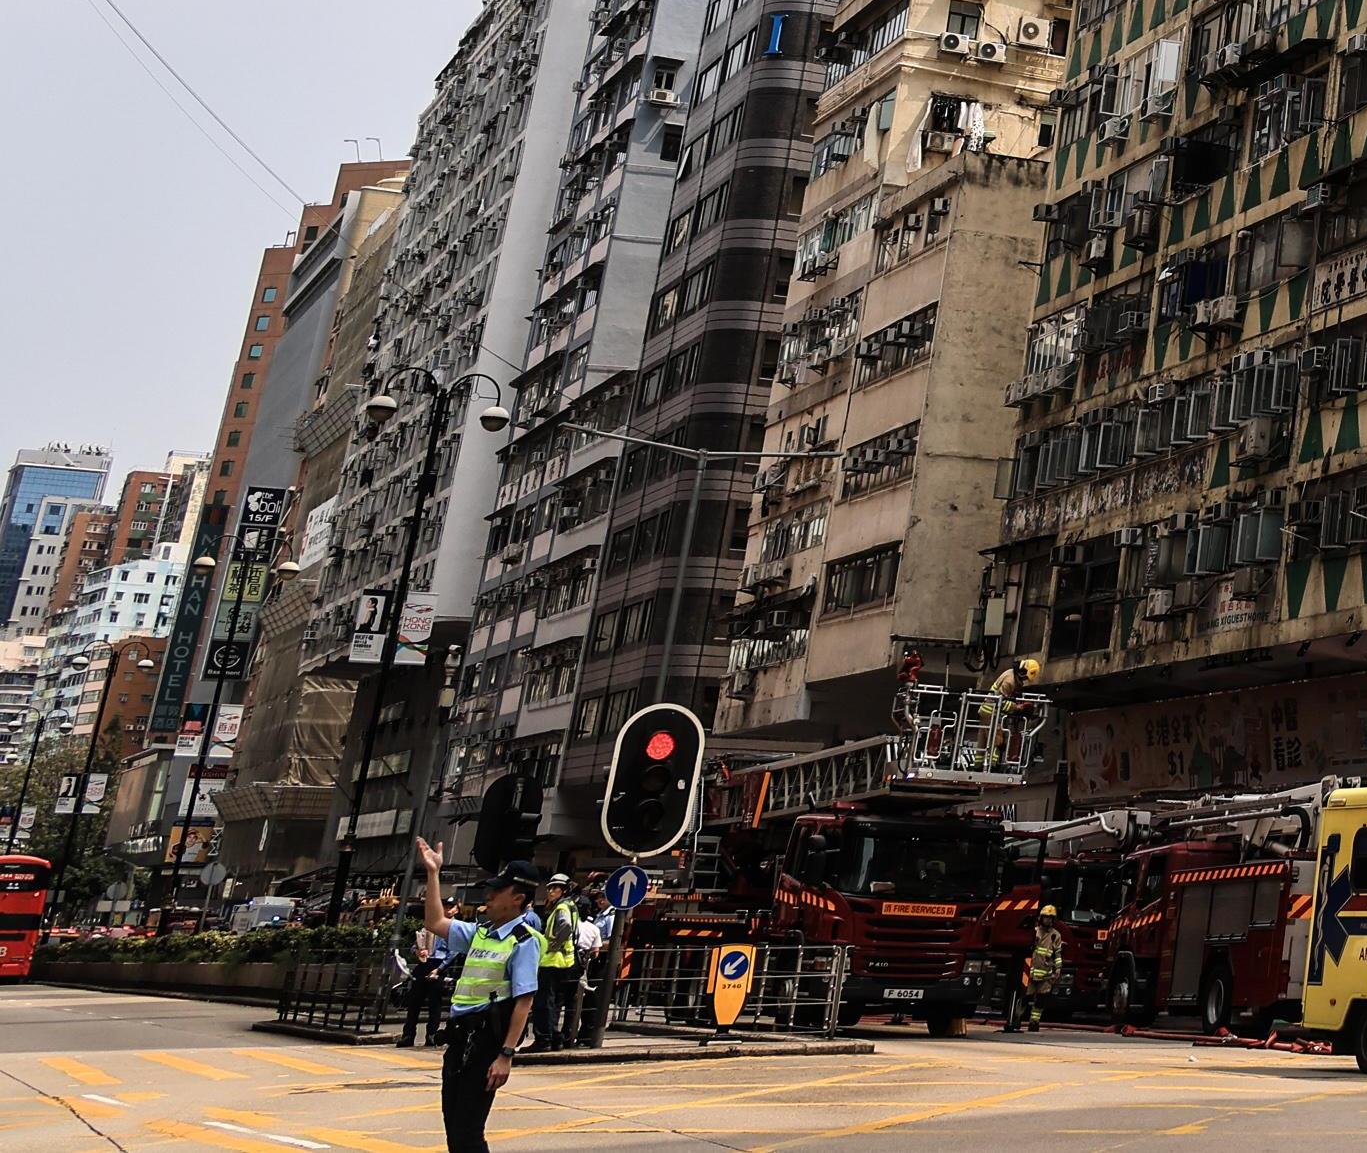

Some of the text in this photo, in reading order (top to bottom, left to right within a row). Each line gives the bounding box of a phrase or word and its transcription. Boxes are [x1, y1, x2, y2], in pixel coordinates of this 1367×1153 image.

[249, 513, 273, 522] 15/F
[184, 534, 217, 616] NHAN
[404, 616, 432, 624] HONG
[164, 631, 193, 701] HOTEL
[1167, 750, 1185, 777] $1
[893, 904, 910, 914] FIRE
[910, 905, 945, 915] SERVICES
[888, 989, 919, 998] F 6054
